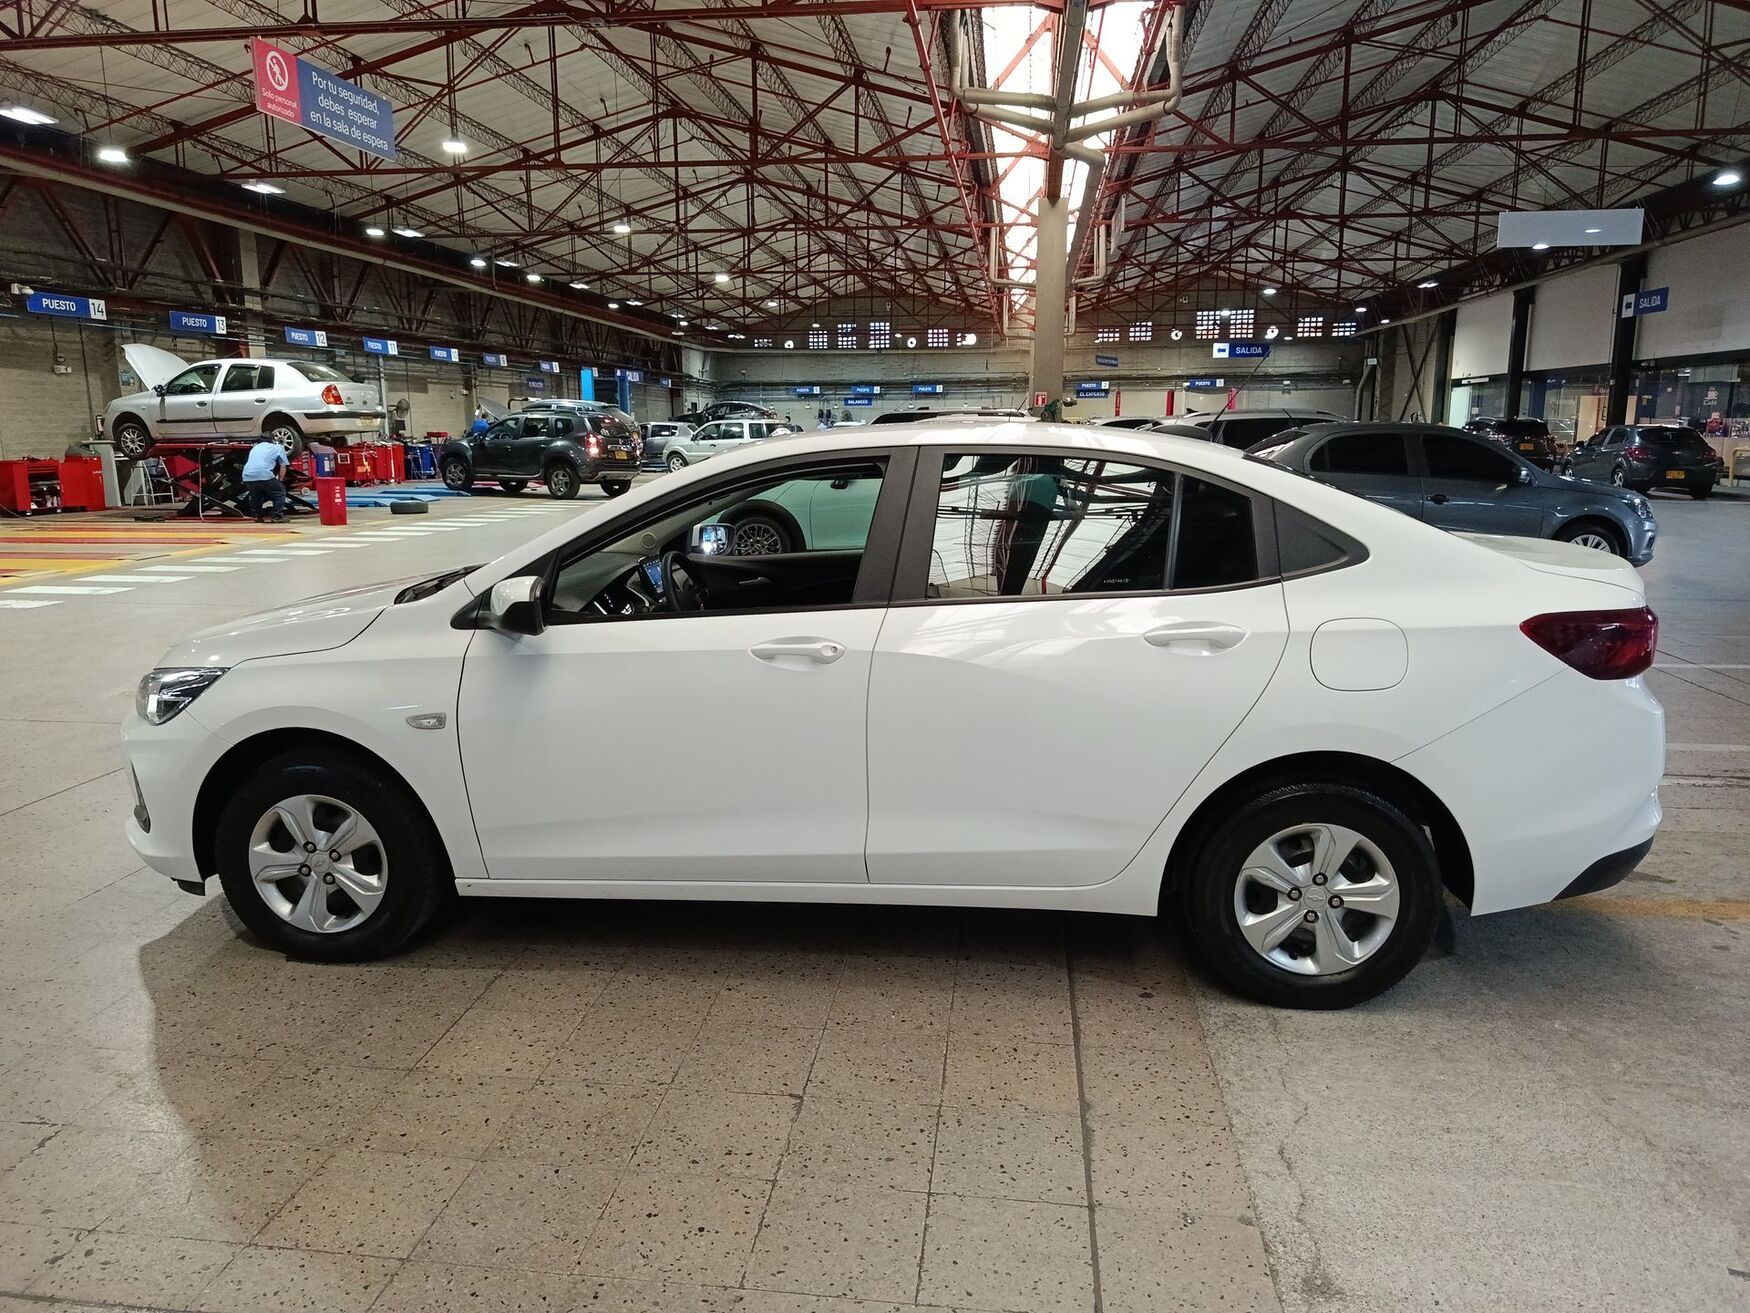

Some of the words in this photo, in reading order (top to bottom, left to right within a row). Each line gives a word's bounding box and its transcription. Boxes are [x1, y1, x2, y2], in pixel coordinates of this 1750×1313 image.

[312, 72, 327, 90] Por
[328, 80, 337, 95] tu
[338, 87, 380, 115] seguridad,
[275, 94, 298, 109] personal
[318, 94, 344, 116] debes
[347, 111, 378, 130] esperar
[311, 111, 323, 124] en
[323, 113, 331, 128] la
[332, 119, 349, 136] sala
[350, 125, 362, 140] de
[363, 134, 389, 150] espera
[42, 298, 76, 311] PUESTO
[91, 303, 104, 316] 14
[1639, 295, 1661, 308] SALIDA
[182, 317, 207, 328] PUESTO
[217, 319, 225, 331] 13
[291, 332, 309, 342] PUESTO
[317, 333, 326, 344] 12
[389, 343, 396, 353] 11
